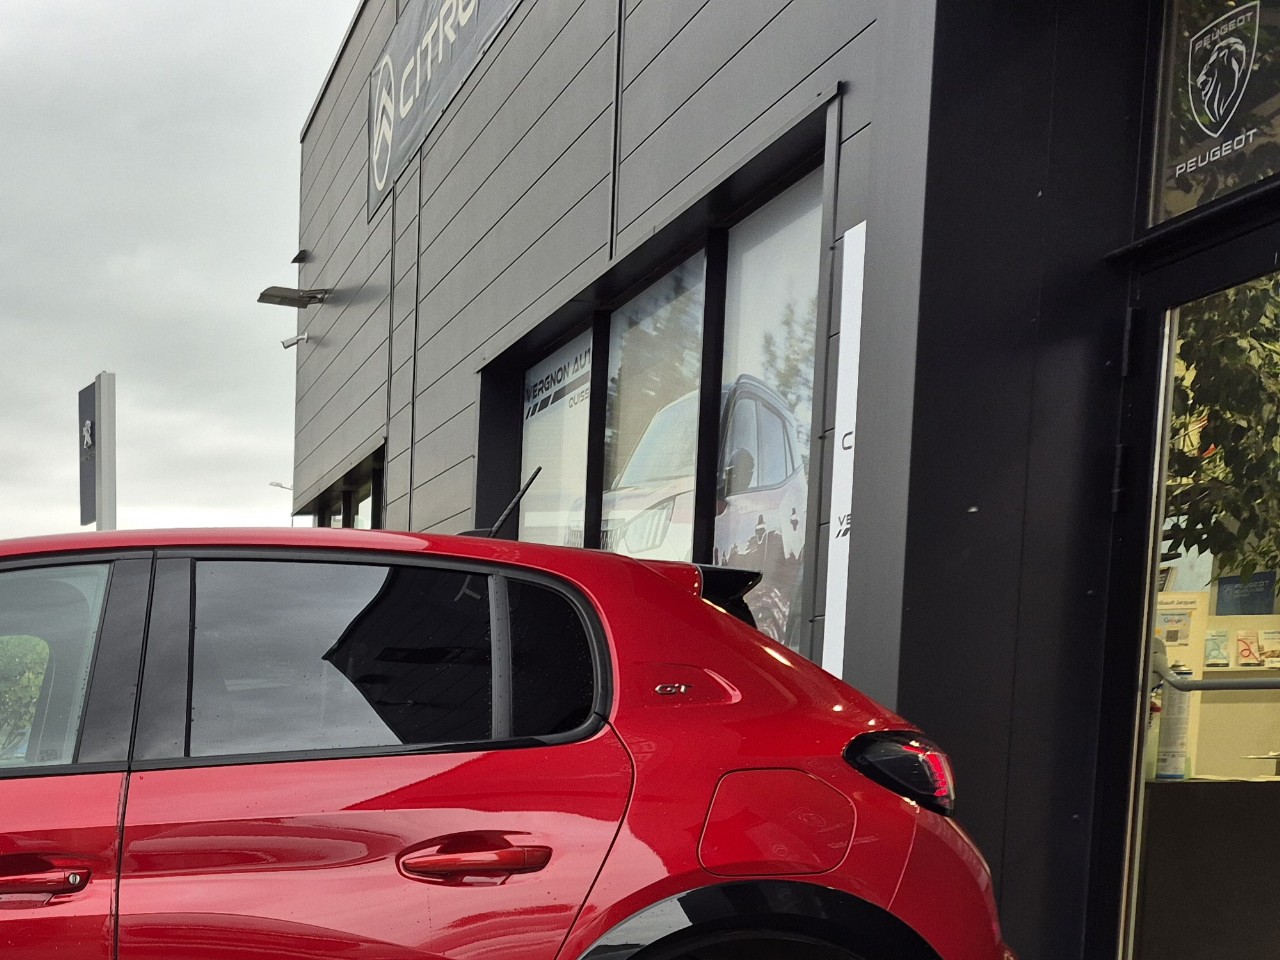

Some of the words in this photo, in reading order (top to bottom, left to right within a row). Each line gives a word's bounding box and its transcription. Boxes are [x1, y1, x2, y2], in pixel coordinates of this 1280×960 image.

[1195, 11, 1254, 52] PEUGEOT
[1175, 128, 1258, 178] PEUGEOT
[526, 361, 570, 403] VERGNON
[654, 683, 693, 695] GT
